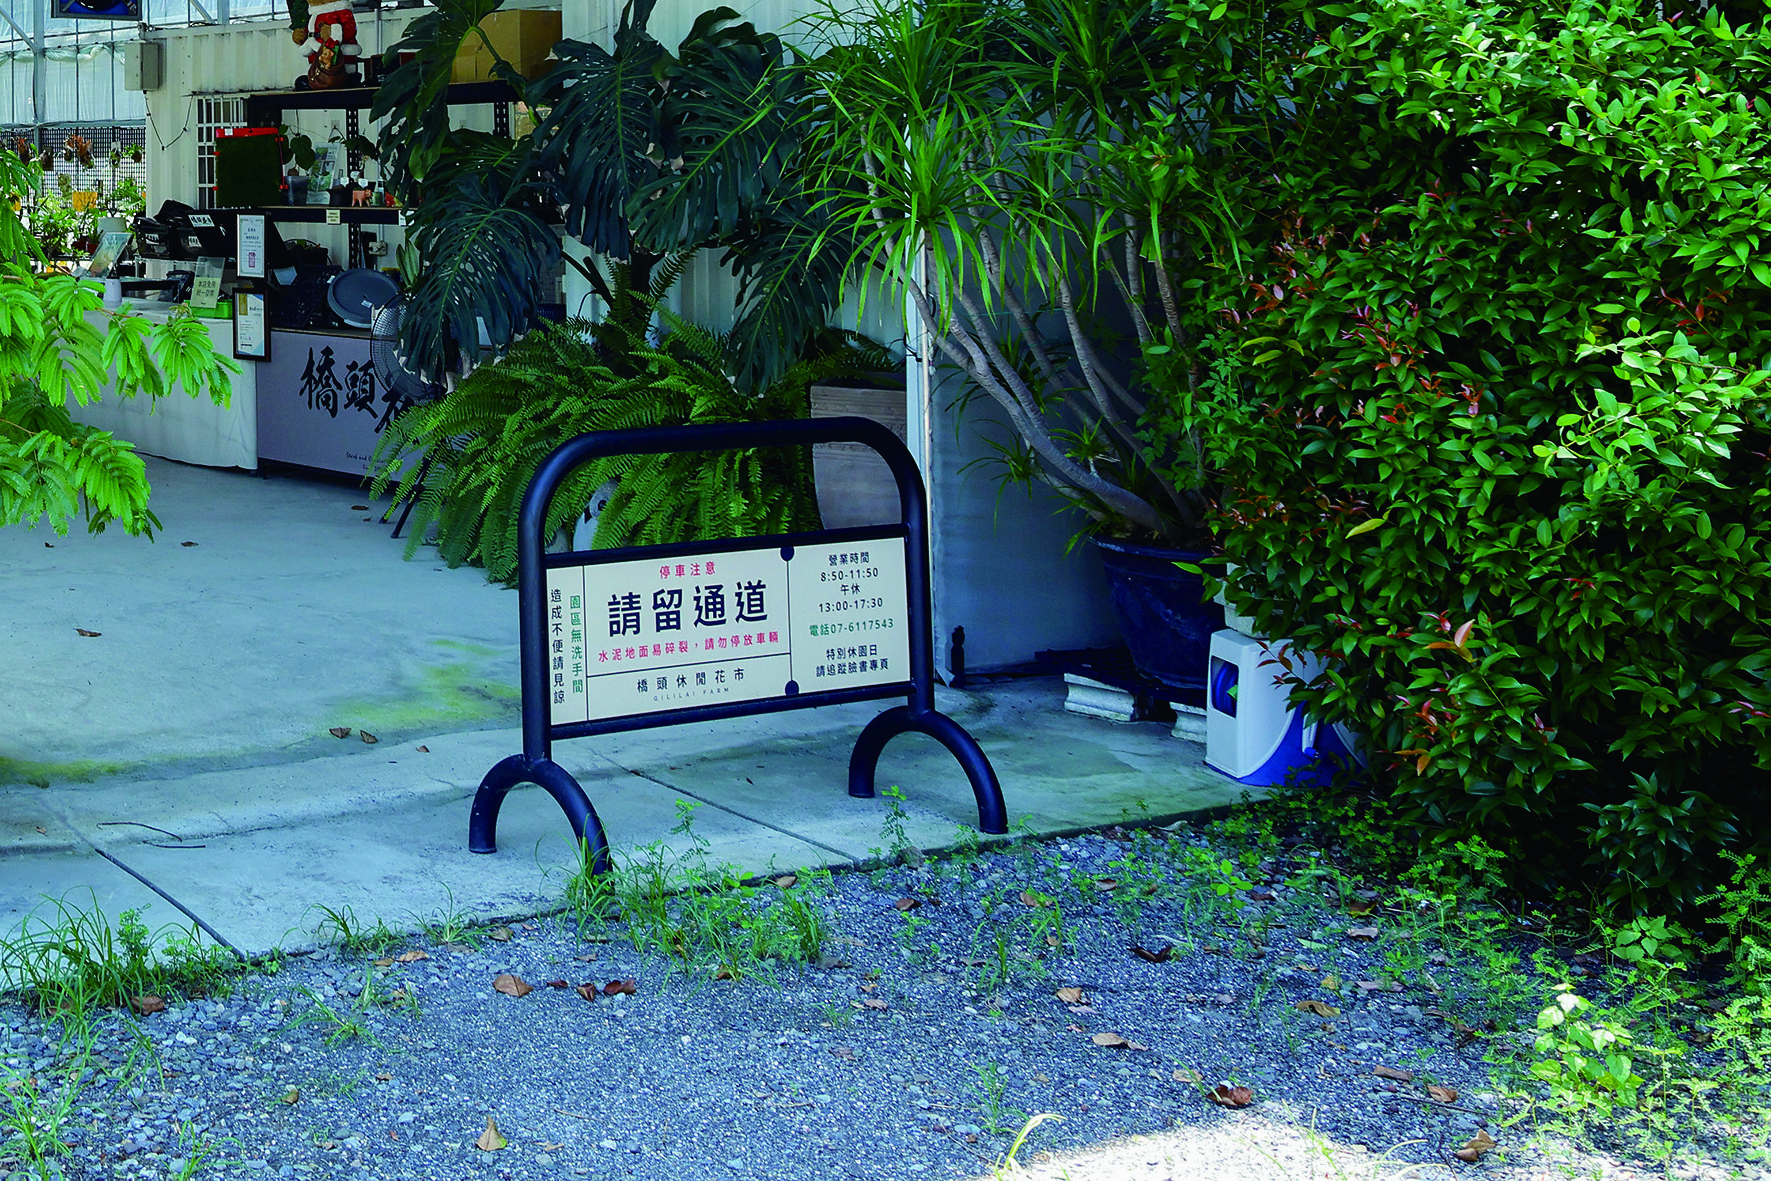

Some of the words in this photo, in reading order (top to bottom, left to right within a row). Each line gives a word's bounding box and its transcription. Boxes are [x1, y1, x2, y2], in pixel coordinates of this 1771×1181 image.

[828, 551, 870, 567] 營業時間
[659, 561, 716, 580] 停車注意
[820, 567, 879, 582] 8:50-11:50
[840, 583, 861, 596] 午休
[607, 579, 768, 638] 請留通道
[818, 597, 884, 613] 13:00-17:30
[809, 618, 895, 637] 電話07-6117543
[550, 589, 566, 704] 造成不便請見諒
[569, 595, 584, 694] 園區無洗手間
[598, 630, 780, 663] 水泥地面易碎裂，請勿停放車輛
[826, 644, 878, 661] 特別休園日
[816, 658, 889, 678] 請追蹤臉書專頁
[653, 690, 696, 702] GILILAI
[703, 687, 730, 695] FARM
